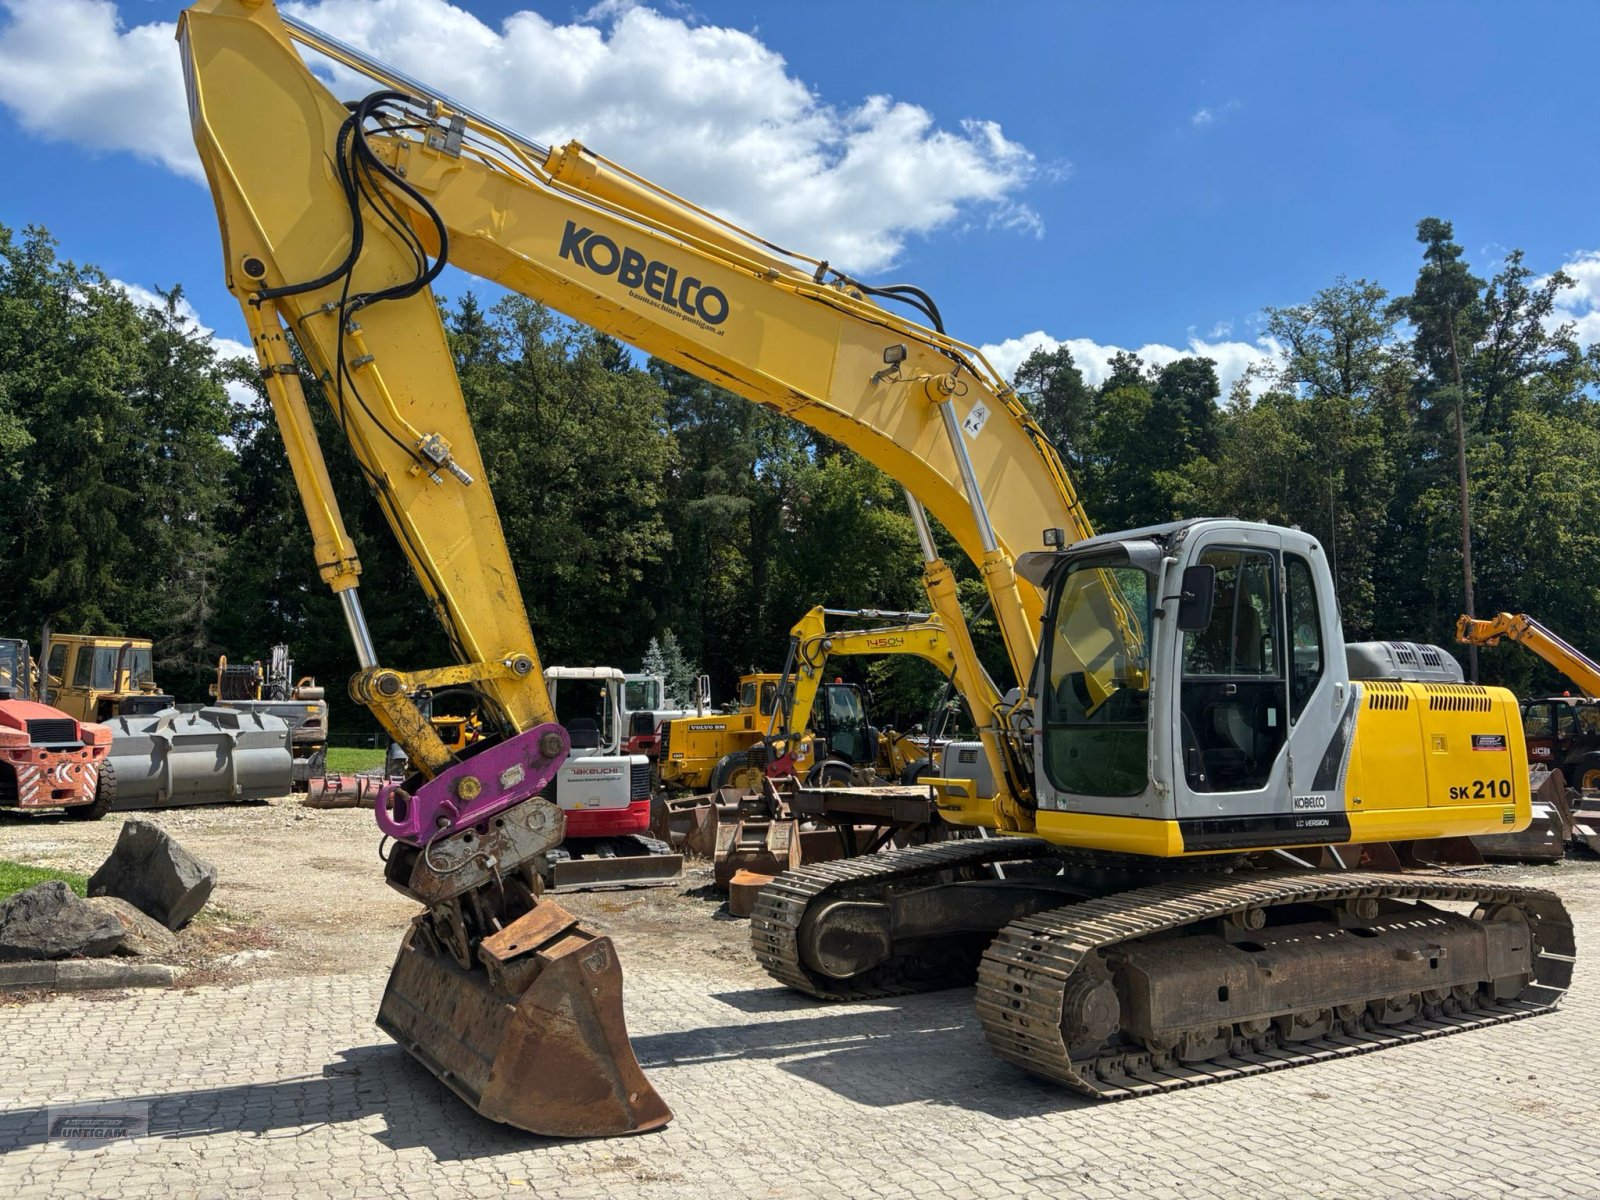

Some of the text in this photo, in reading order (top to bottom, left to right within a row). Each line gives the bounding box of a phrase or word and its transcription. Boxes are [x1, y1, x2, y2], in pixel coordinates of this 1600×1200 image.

[559, 220, 729, 325] KOBELCO
[628, 289, 725, 337] baumaschinen-puntigam.at
[1531, 746, 1551, 755] JCB
[1449, 779, 1511, 799] SK 210
[1294, 796, 1326, 809] KOBELCO
[1305, 819, 1330, 827] VERSION
